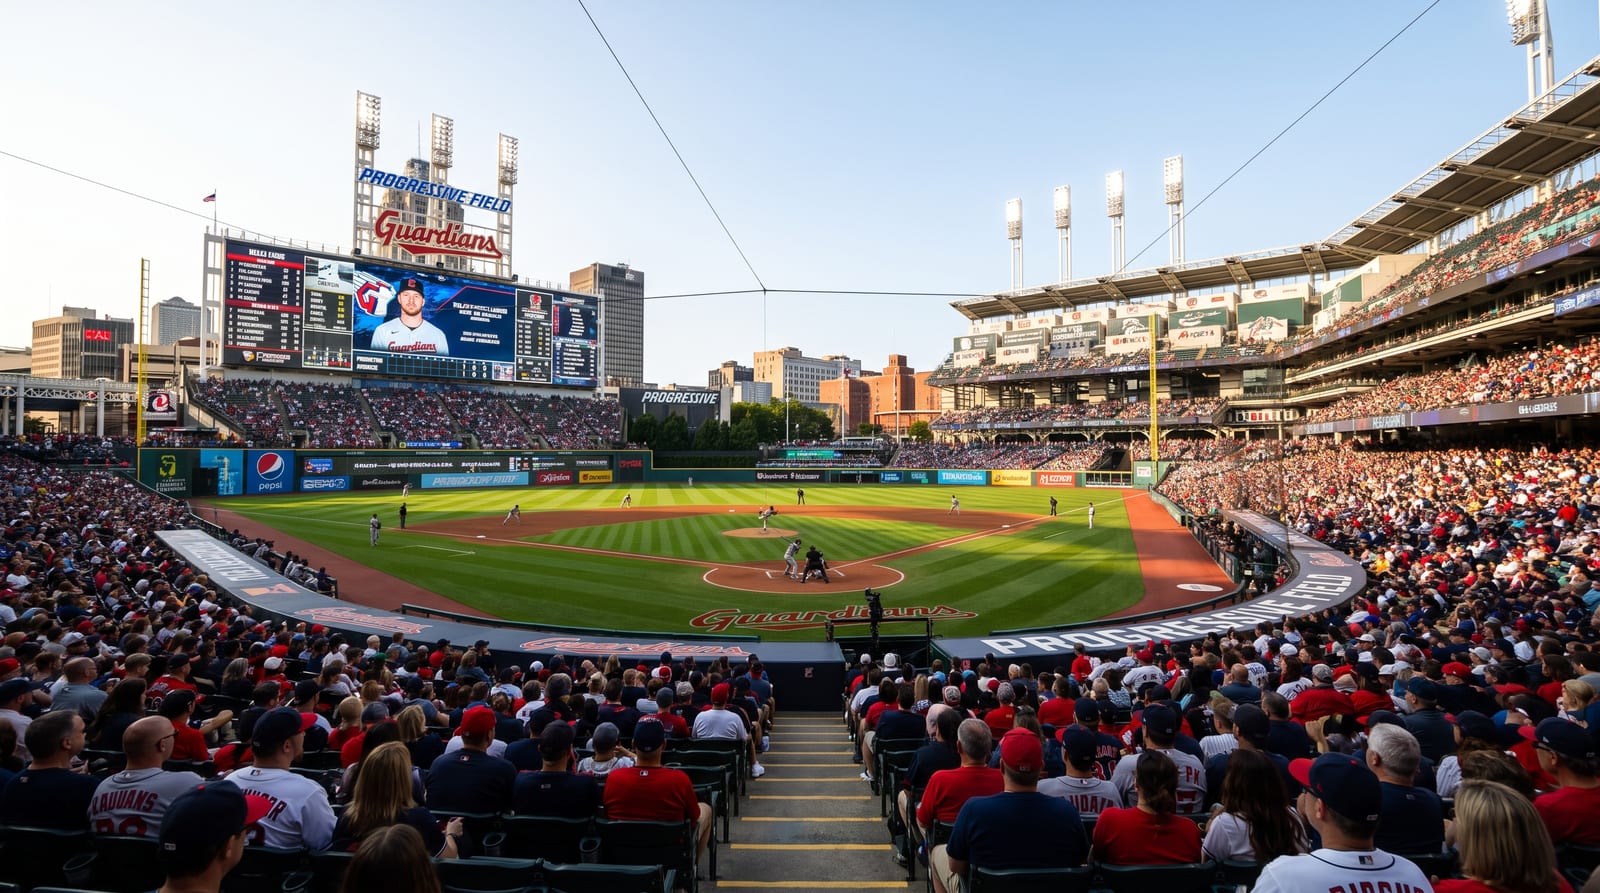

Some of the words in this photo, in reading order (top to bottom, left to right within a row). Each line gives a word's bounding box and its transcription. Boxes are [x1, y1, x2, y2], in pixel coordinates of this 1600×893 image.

[359, 167, 469, 203] PROGRESSIVE
[470, 193, 511, 213] FIELD
[375, 210, 502, 257] Guardians
[388, 340, 437, 354] Guardians
[641, 391, 719, 404] PROGRESSIVE
[258, 482, 283, 491] pepsi
[981, 599, 1318, 655] PROGRESSIVE
[1280, 574, 1352, 602] FIELD
[519, 637, 755, 657] Guardians
